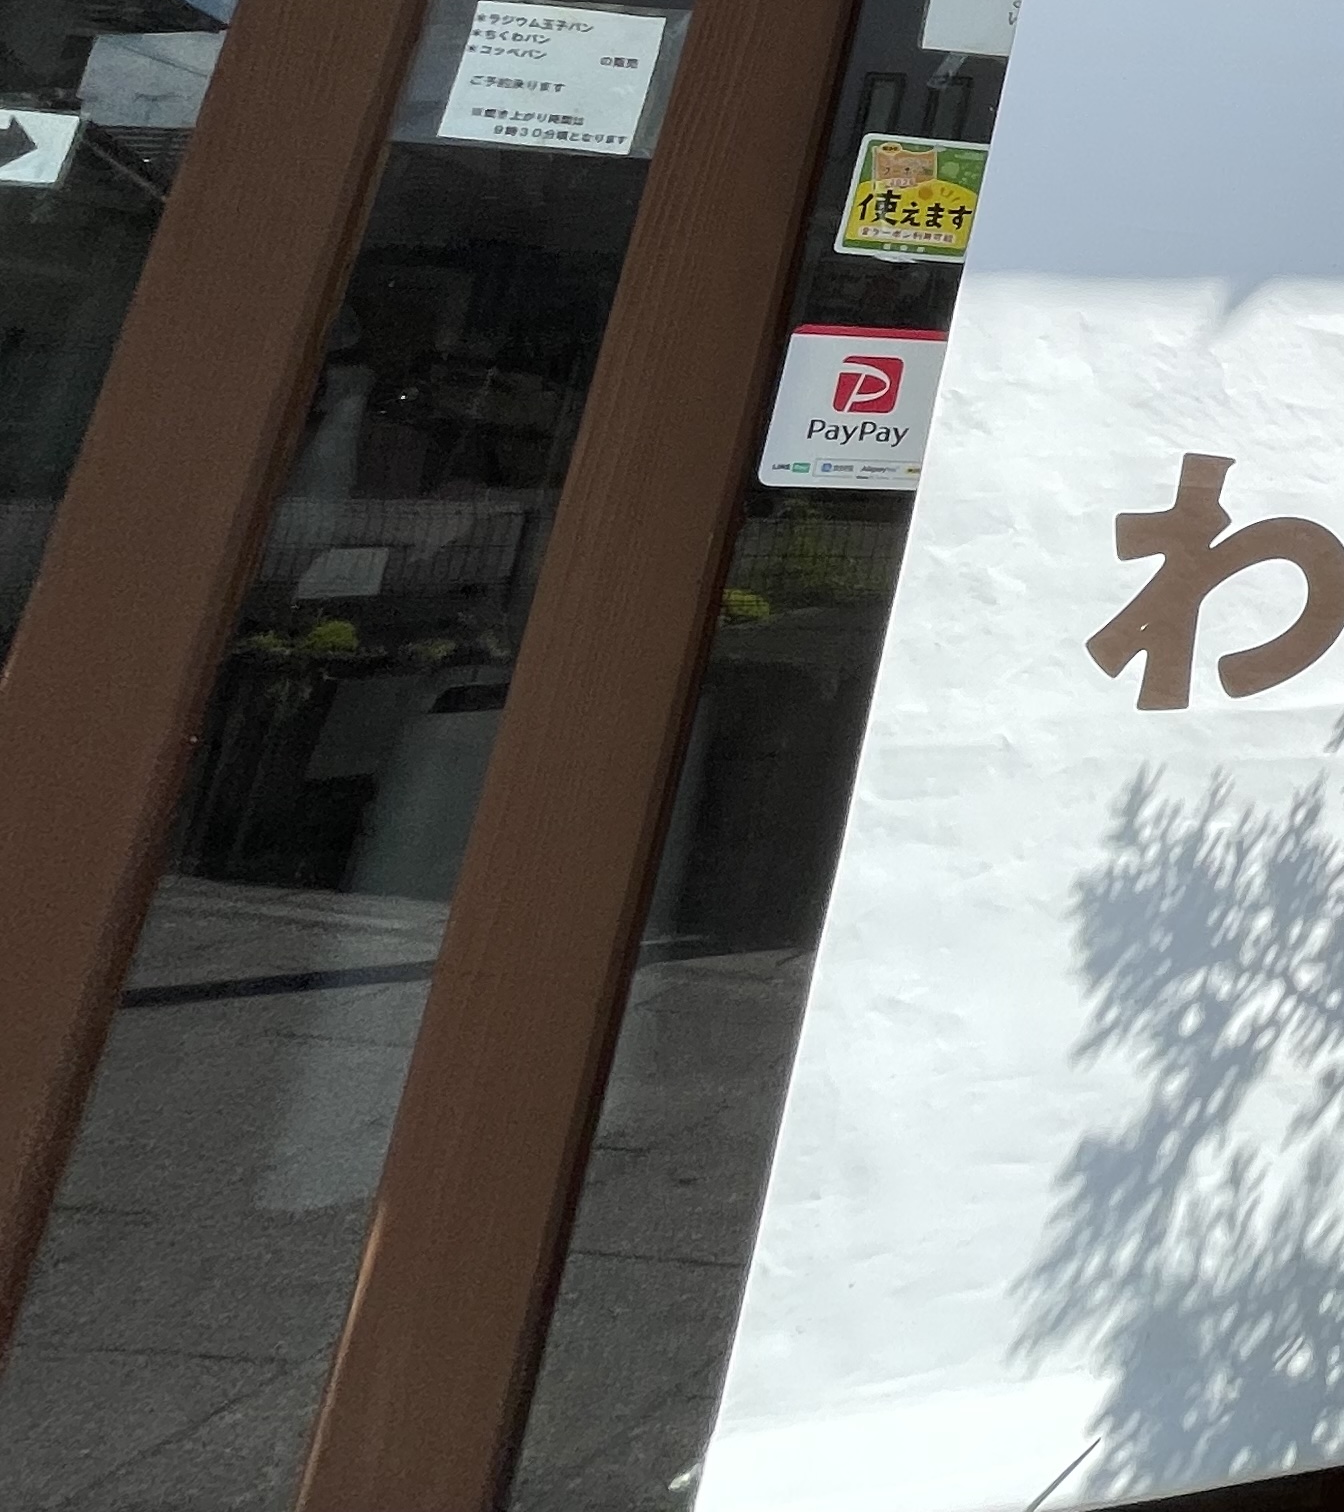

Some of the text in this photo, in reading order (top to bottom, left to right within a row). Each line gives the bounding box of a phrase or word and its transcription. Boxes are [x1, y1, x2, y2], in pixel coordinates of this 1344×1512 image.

[857, 189, 973, 230] 使えます
[806, 419, 910, 448] PayPay
